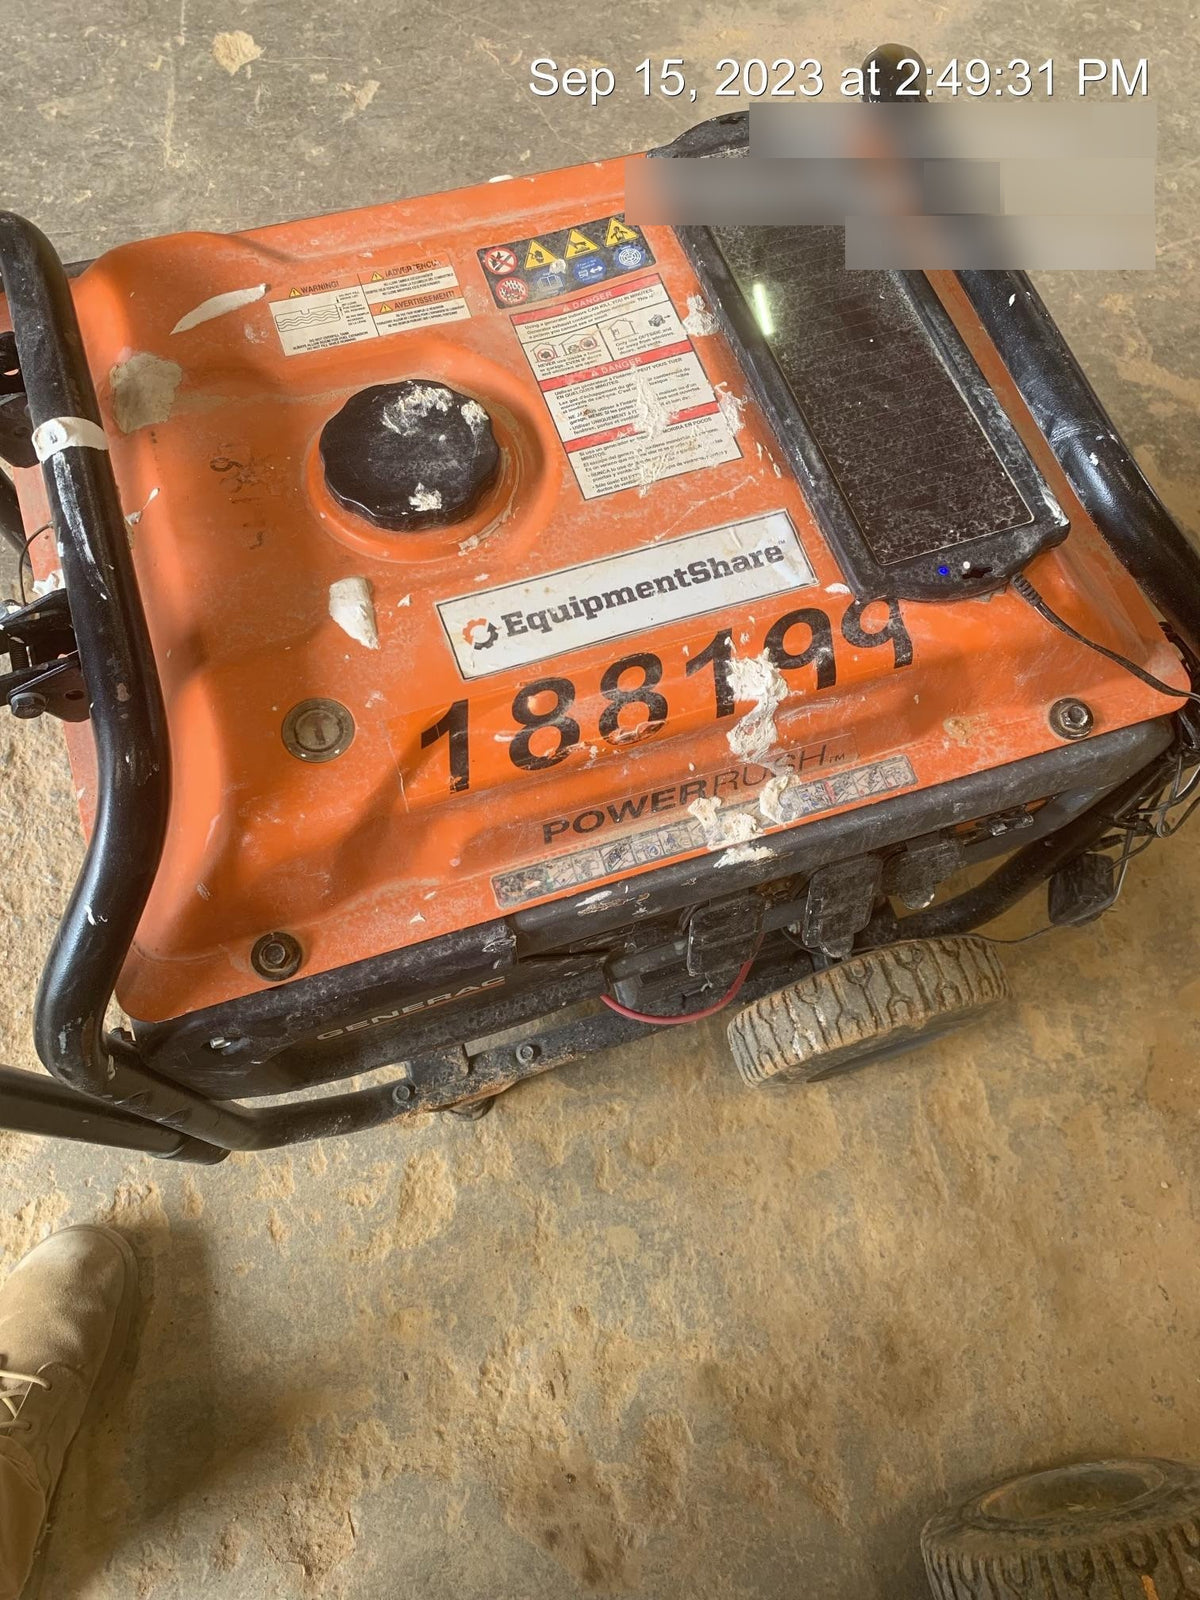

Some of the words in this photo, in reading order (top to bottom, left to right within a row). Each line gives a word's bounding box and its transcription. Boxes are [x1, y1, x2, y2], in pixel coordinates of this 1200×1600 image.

[300, 280, 340, 294] WARNING!
[393, 290, 456, 309] AVERTISSEMENT!
[572, 291, 612, 310] DANGER
[601, 357, 641, 375] DANGER
[692, 416, 712, 425] POCOS
[501, 545, 785, 638] EquipmentShare
[420, 600, 914, 794] 188199
[317, 975, 505, 1041] GENERAC
